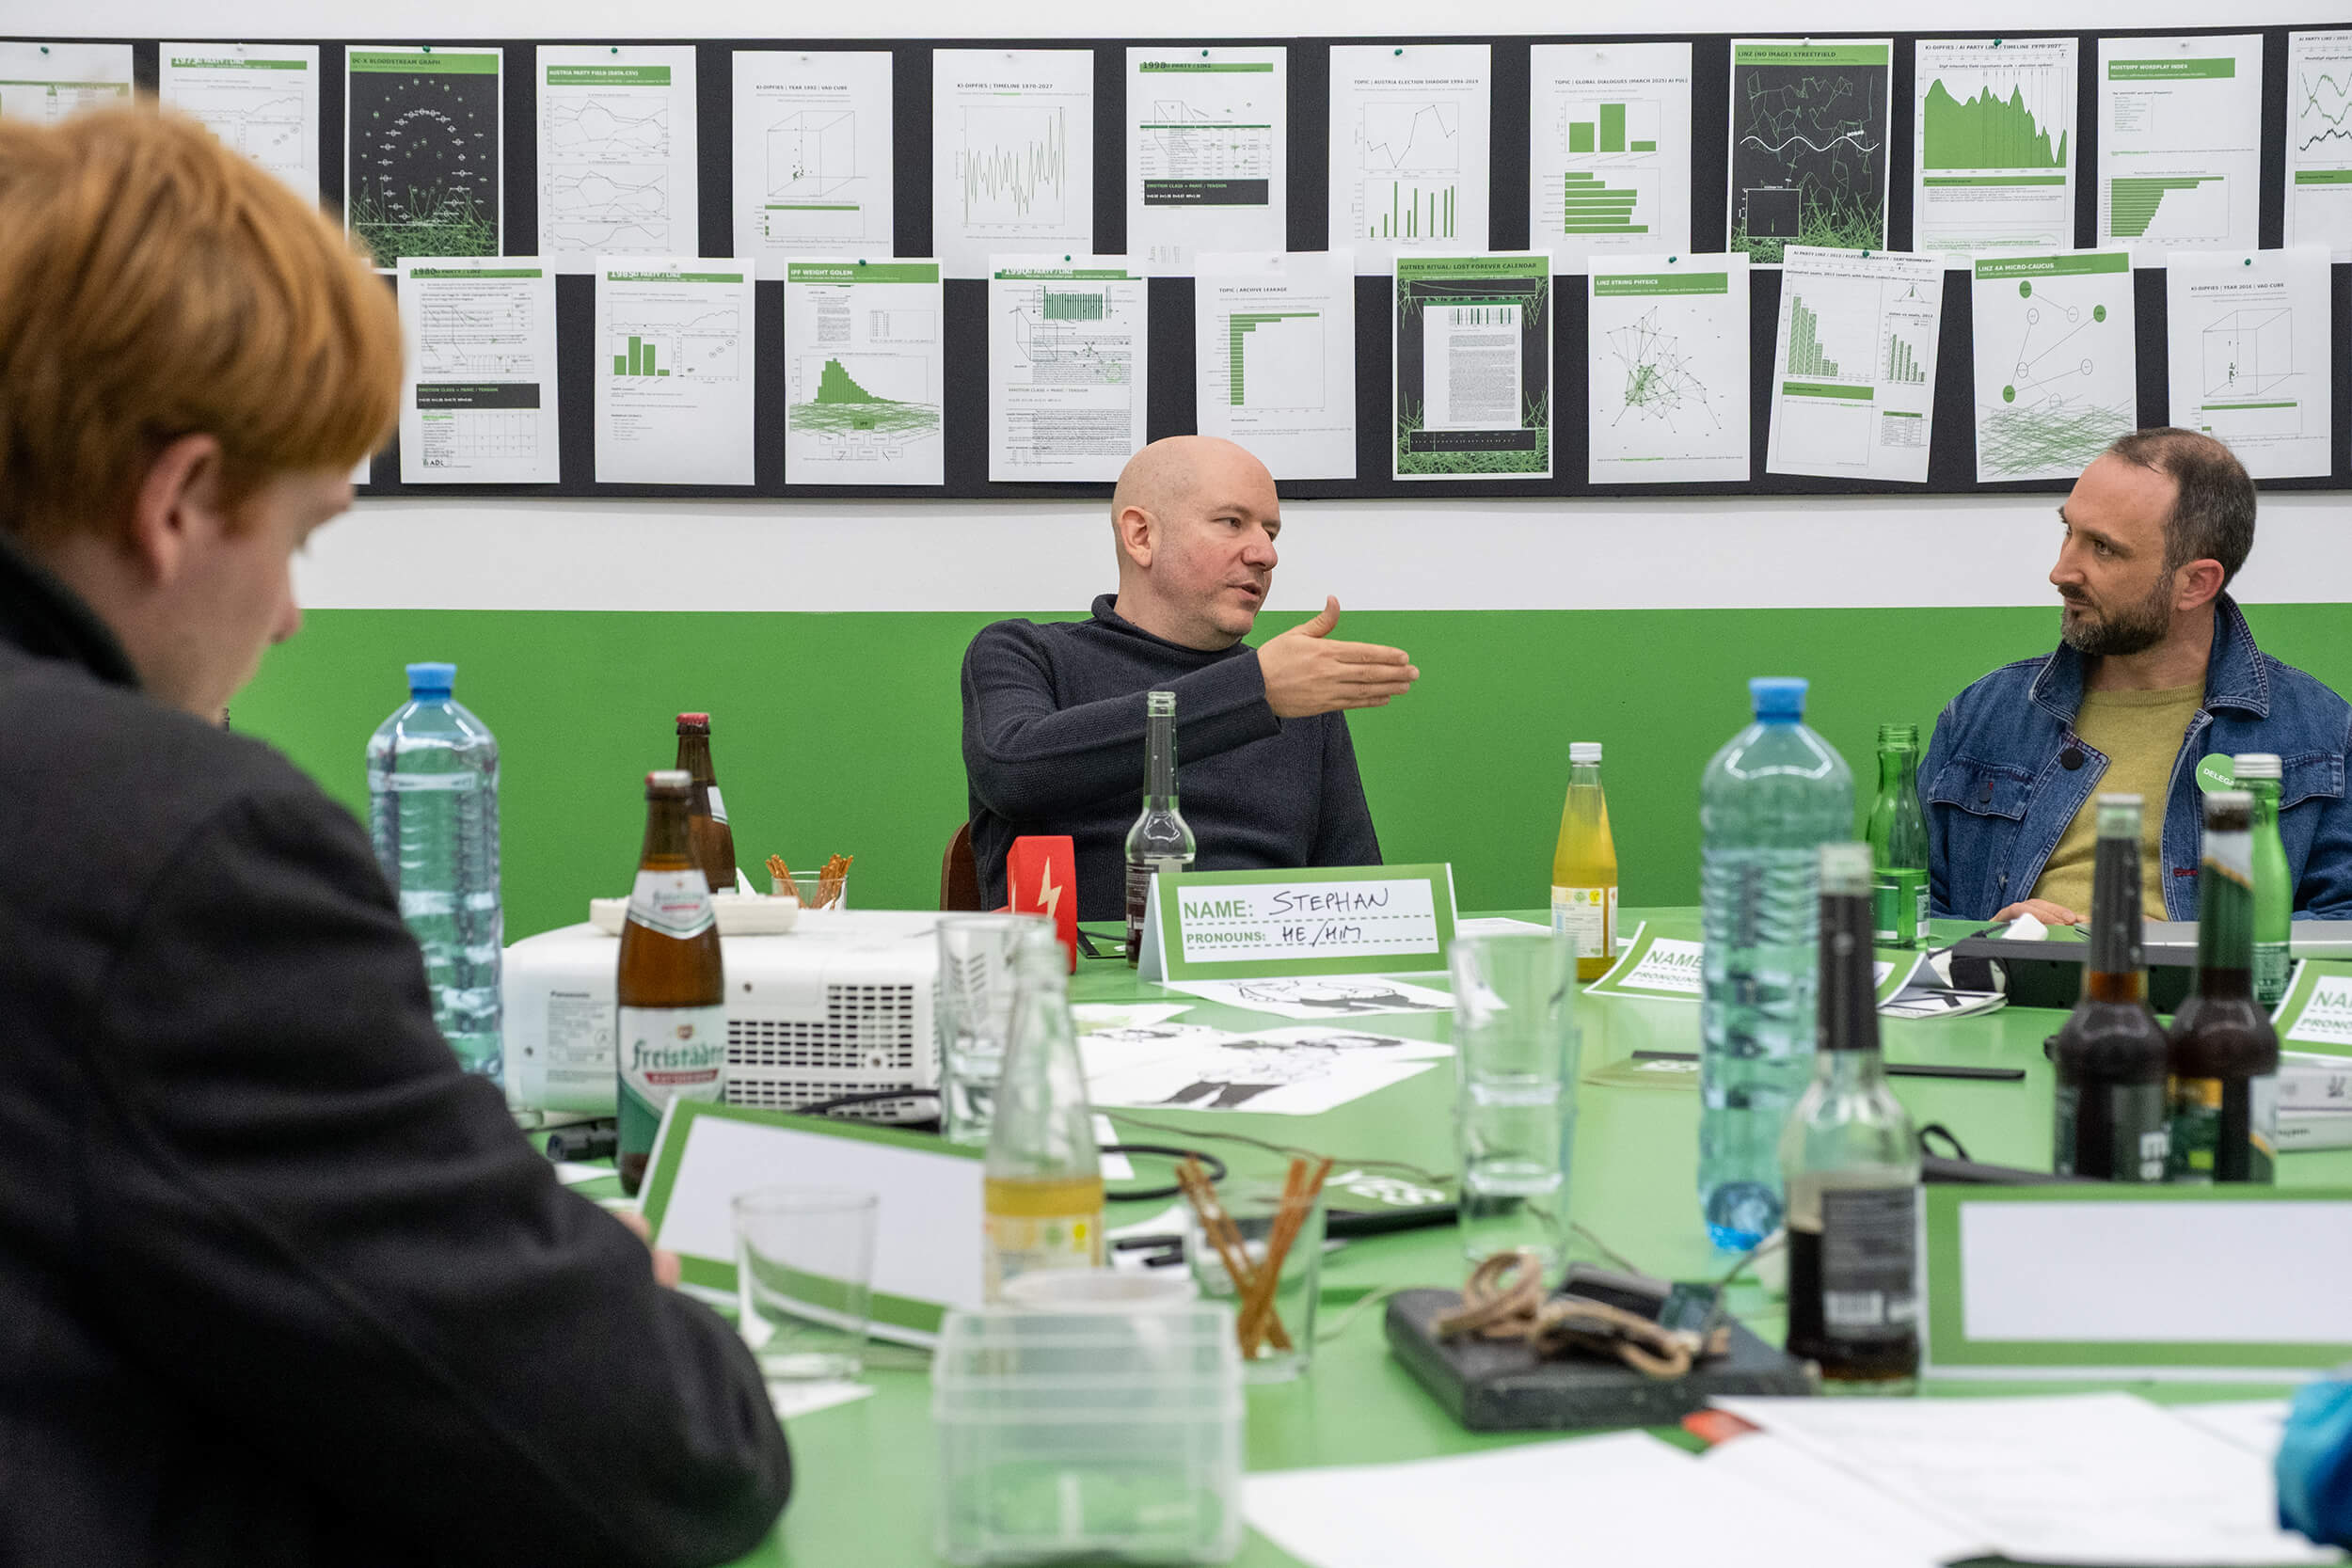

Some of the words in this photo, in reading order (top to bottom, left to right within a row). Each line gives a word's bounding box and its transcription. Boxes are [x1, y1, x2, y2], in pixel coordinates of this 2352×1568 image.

[2006, 262, 2055, 271] MICRO-CAUCUS
[1184, 899, 1253, 919] NAME:
[1269, 887, 1389, 916] STEPHAN
[1187, 930, 1266, 943] PRONOUNS:
[2314, 990, 2352, 1009] NA
